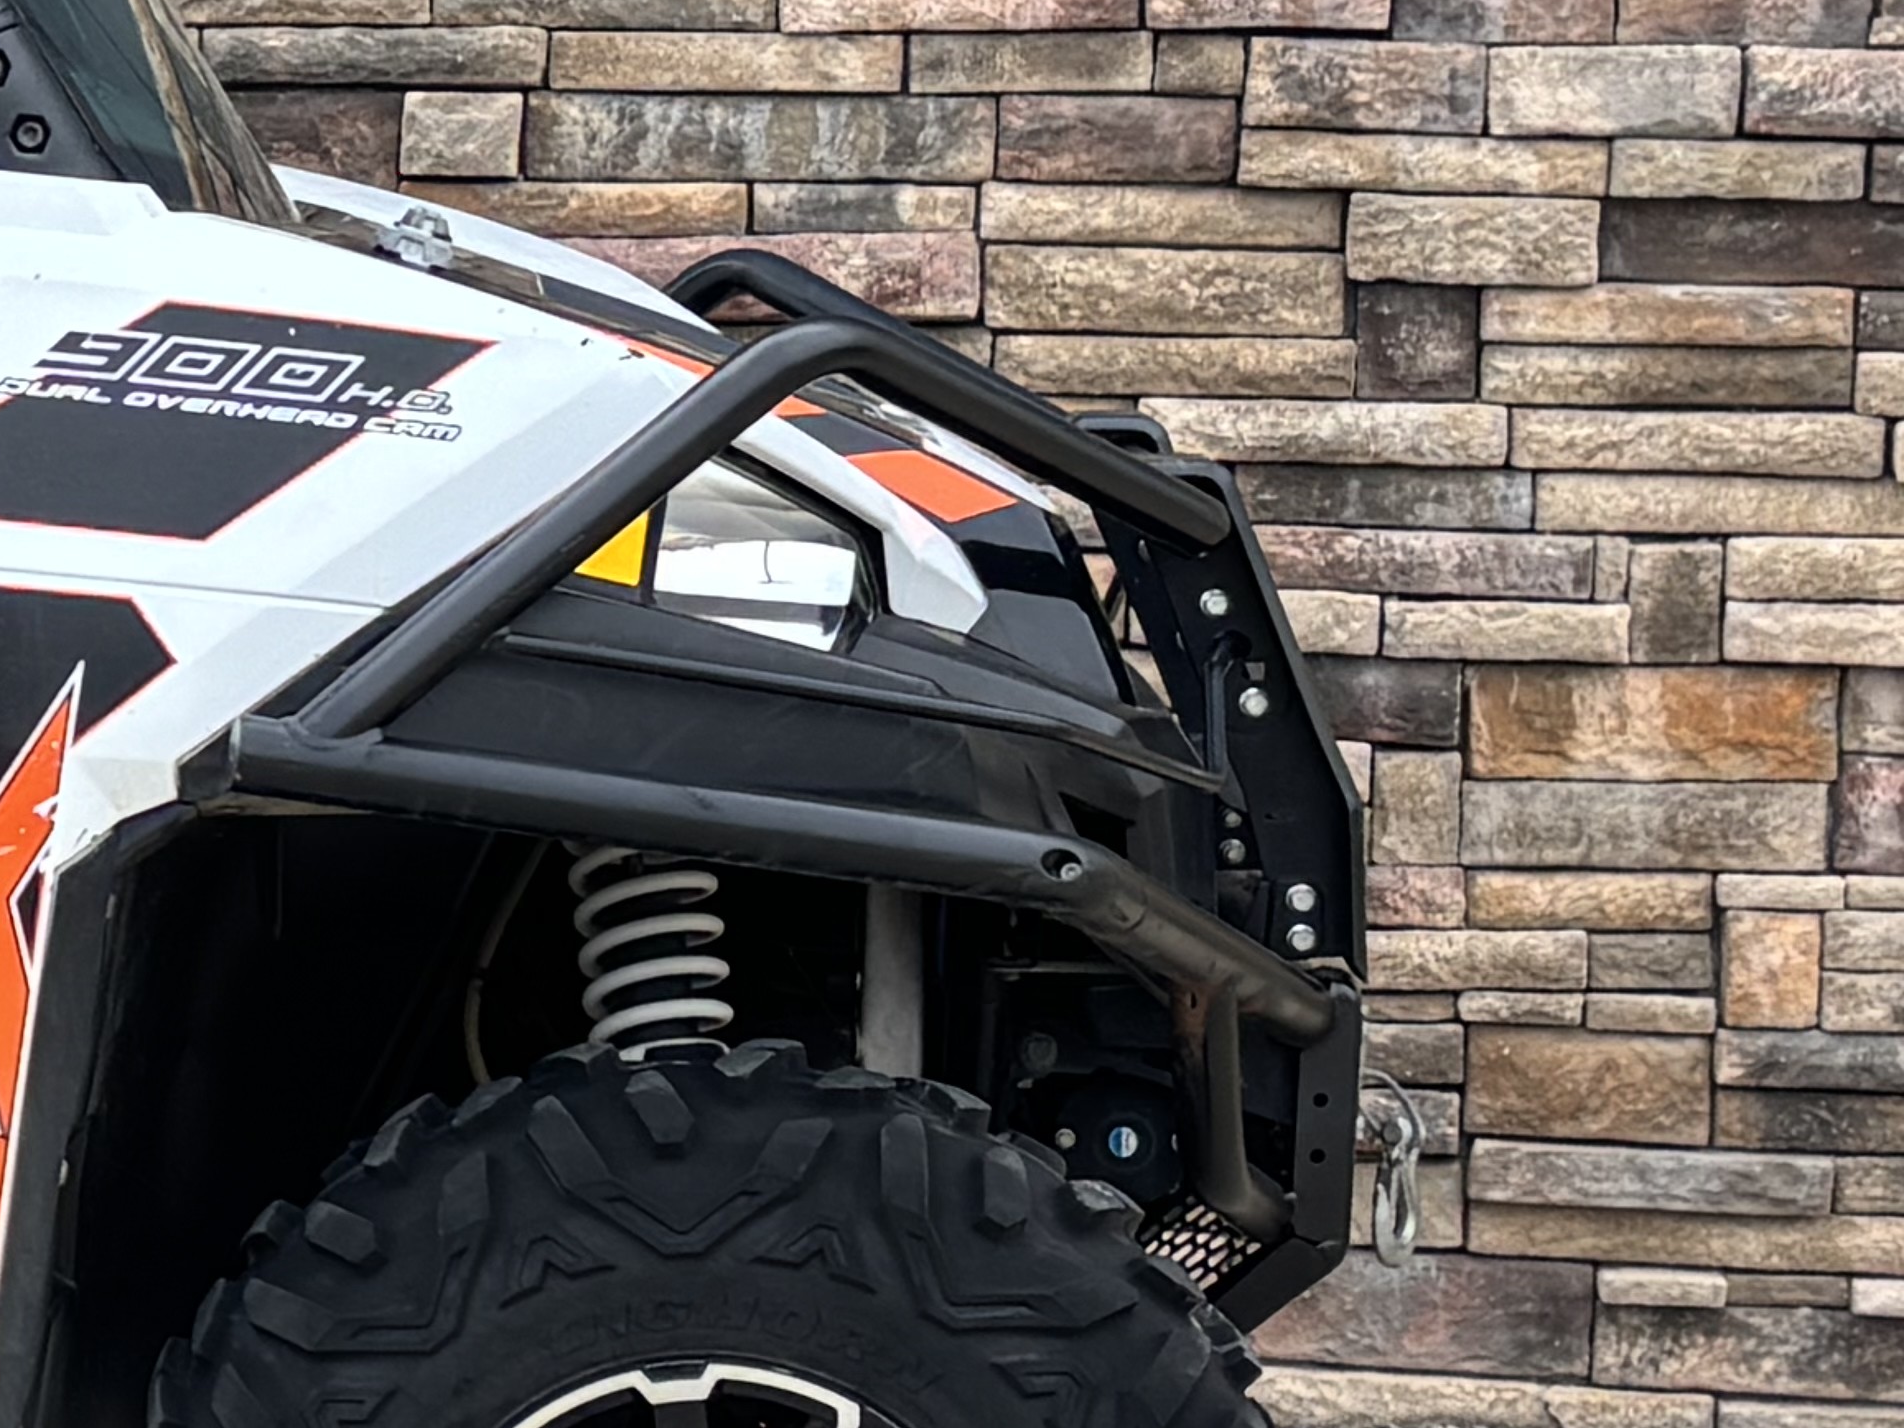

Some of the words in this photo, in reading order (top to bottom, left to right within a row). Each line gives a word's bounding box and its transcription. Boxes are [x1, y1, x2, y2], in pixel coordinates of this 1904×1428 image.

[33, 330, 366, 402] 900
[122, 391, 358, 430] OVERHEAD
[362, 417, 463, 442] CAM
